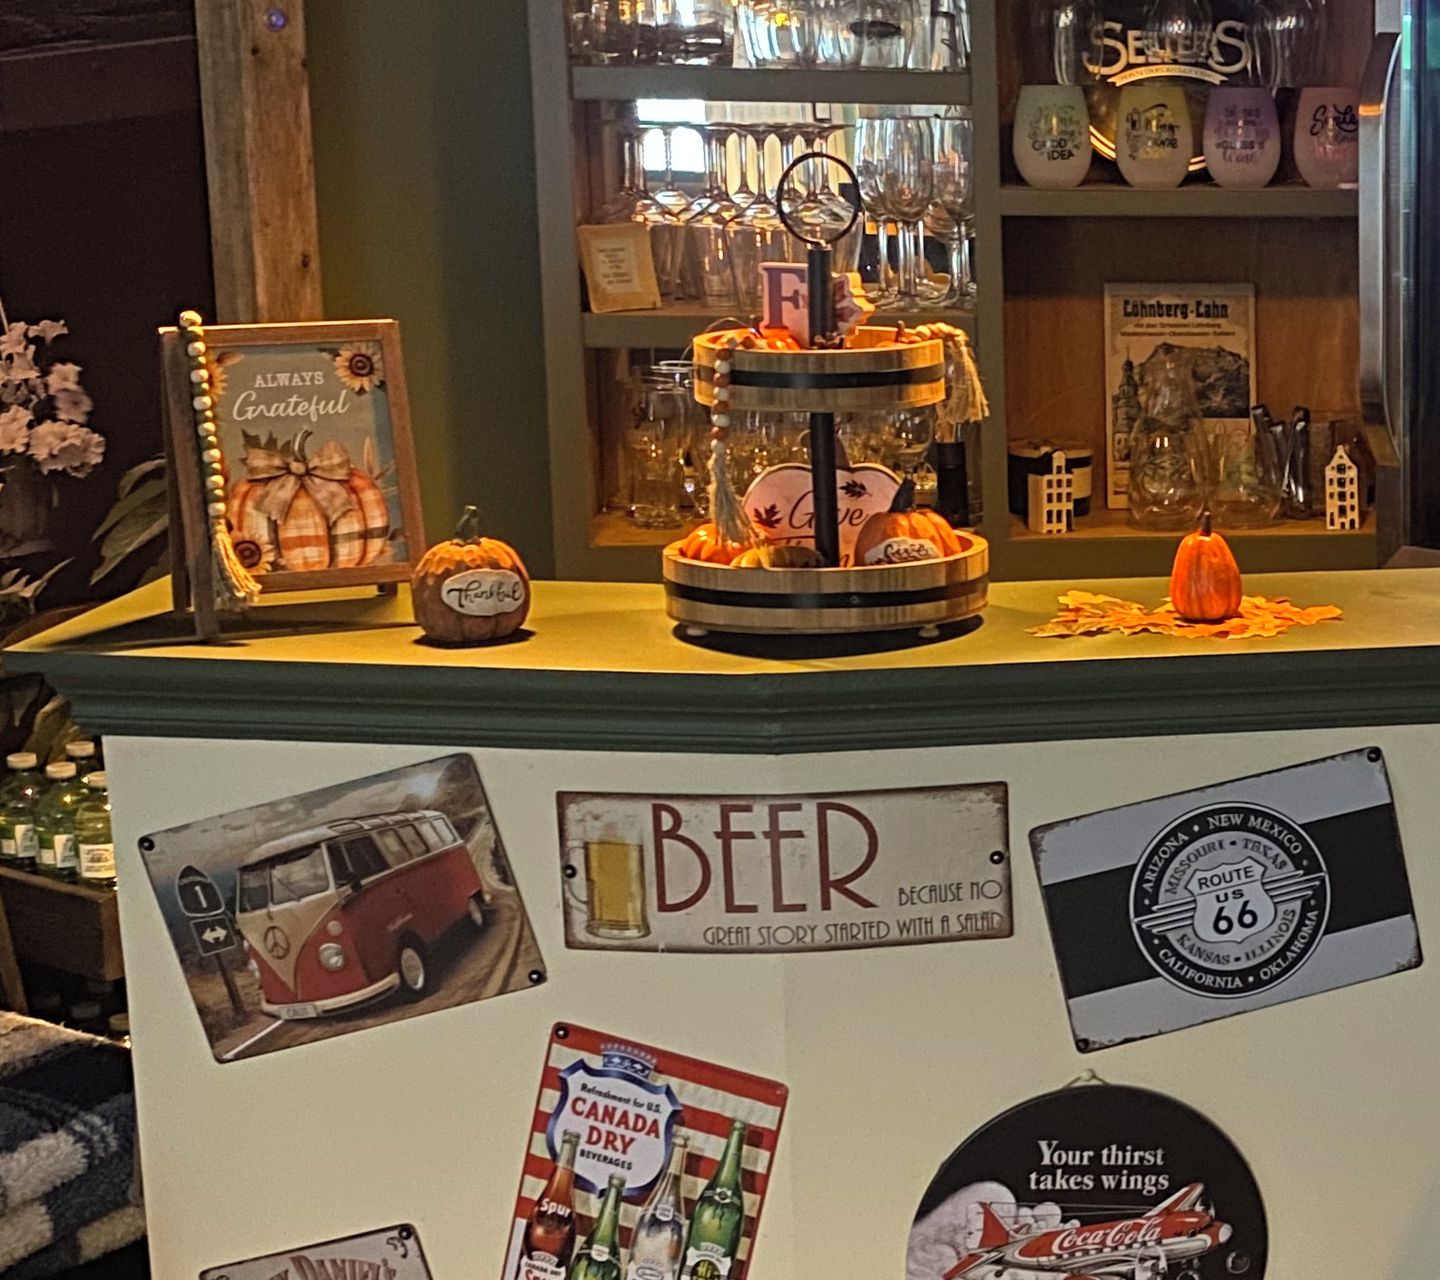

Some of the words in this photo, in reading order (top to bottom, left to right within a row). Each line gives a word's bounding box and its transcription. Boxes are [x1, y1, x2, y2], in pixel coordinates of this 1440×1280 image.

[1046, 150, 1075, 160] IDEA
[254, 371, 325, 388] ALWAYS
[232, 390, 352, 422] Grateful
[789, 490, 869, 529] Gve
[446, 580, 523, 608] Thankful
[1207, 814, 1244, 830] NEW
[1247, 815, 1302, 855] MEXICO
[651, 801, 879, 913] BEER
[1142, 832, 1189, 892] ARIZONA
[1164, 839, 1225, 895] MISSOURI
[1242, 838, 1287, 870] TEXAS
[898, 882, 963, 907] BECAUSE
[969, 879, 1003, 901] NO
[1197, 866, 1254, 890] ROUTE
[194, 885, 207, 908] 1
[1215, 889, 1244, 903] US
[703, 926, 752, 947] GREAT
[757, 924, 819, 945] STORY
[825, 920, 891, 944] STARTED
[896, 916, 934, 937] WITH
[940, 915, 950, 934] A
[956, 911, 1005, 933] SALAD
[1213, 900, 1258, 935] 66
[1176, 933, 1230, 965] KANSAS
[1245, 909, 1296, 961] ILLINOIS
[1260, 910, 1319, 981] OKLAHOMA
[1159, 948, 1243, 988] CALIFORNIA
[581, 1083, 632, 1104] Refreshment
[633, 1098, 645, 1109] for
[571, 1097, 661, 1139] CANADA
[586, 1125, 637, 1156] DRY
[1037, 1140, 1094, 1166] Your
[1101, 1144, 1165, 1166] thirst
[580, 1149, 633, 1171] BEVERAGES
[1029, 1168, 1094, 1190] takes
[1101, 1170, 1169, 1196] wings
[540, 1198, 571, 1218] Spur
[1052, 1216, 1164, 1255] Coca-Cola
